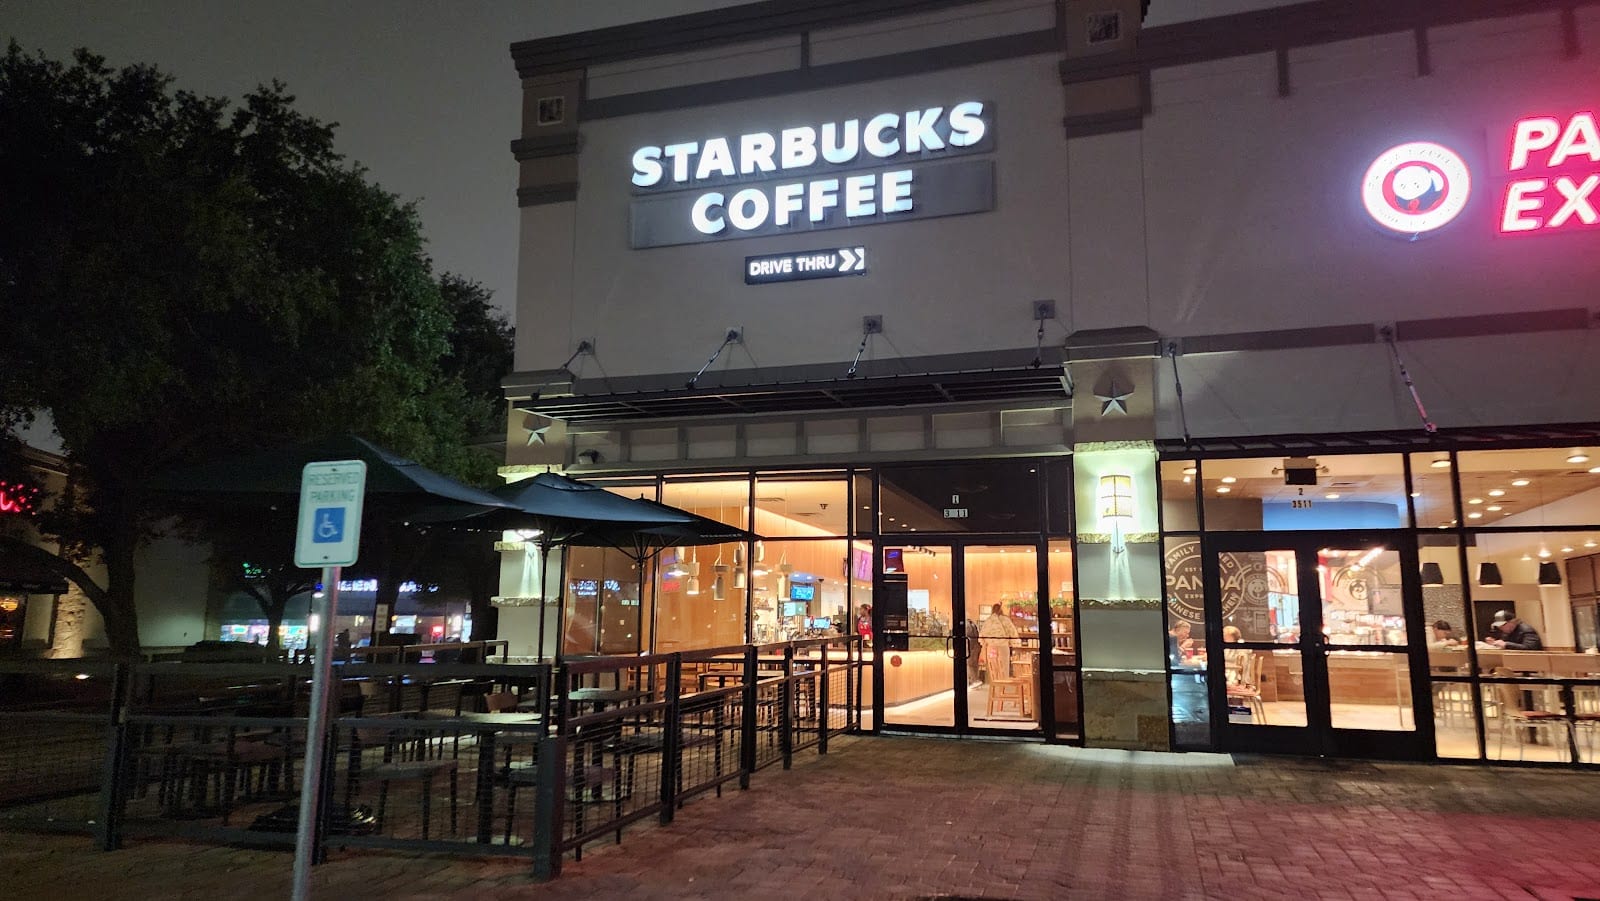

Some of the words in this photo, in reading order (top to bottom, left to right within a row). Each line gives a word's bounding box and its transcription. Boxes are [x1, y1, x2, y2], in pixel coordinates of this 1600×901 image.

[631, 101, 986, 188] STARBUCKS
[691, 169, 914, 235] COFFEE
[749, 258, 793, 277] DRIVE
[796, 254, 836, 273] THRU
[1298, 488, 1304, 496] 2
[1291, 500, 1312, 509] 3511
